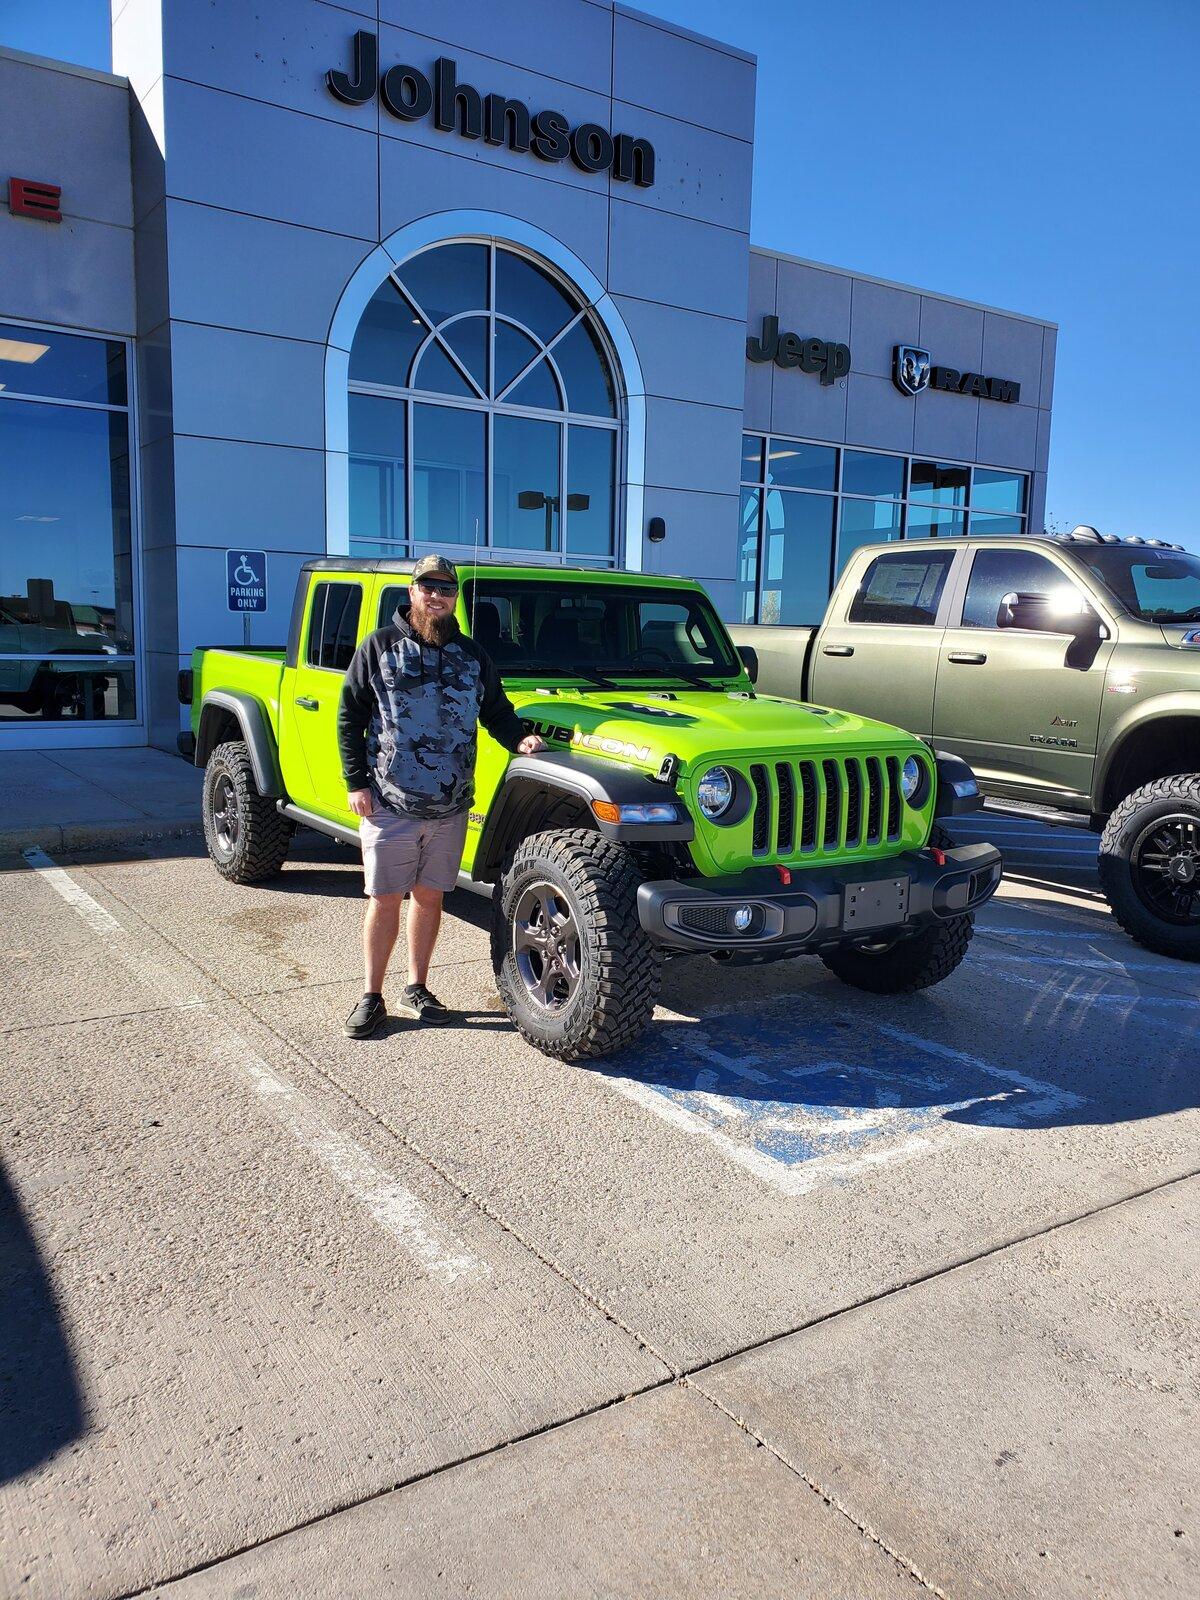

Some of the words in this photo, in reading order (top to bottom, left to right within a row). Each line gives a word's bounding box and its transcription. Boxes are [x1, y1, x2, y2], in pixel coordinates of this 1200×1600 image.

[325, 29, 656, 188] Johnson
[9, 177, 62, 224] E
[746, 315, 851, 386] Jeep
[930, 366, 1021, 403] RAM
[230, 587, 264, 597] PARKING
[237, 598, 258, 608] ONLY
[519, 718, 651, 761] RUBICON
